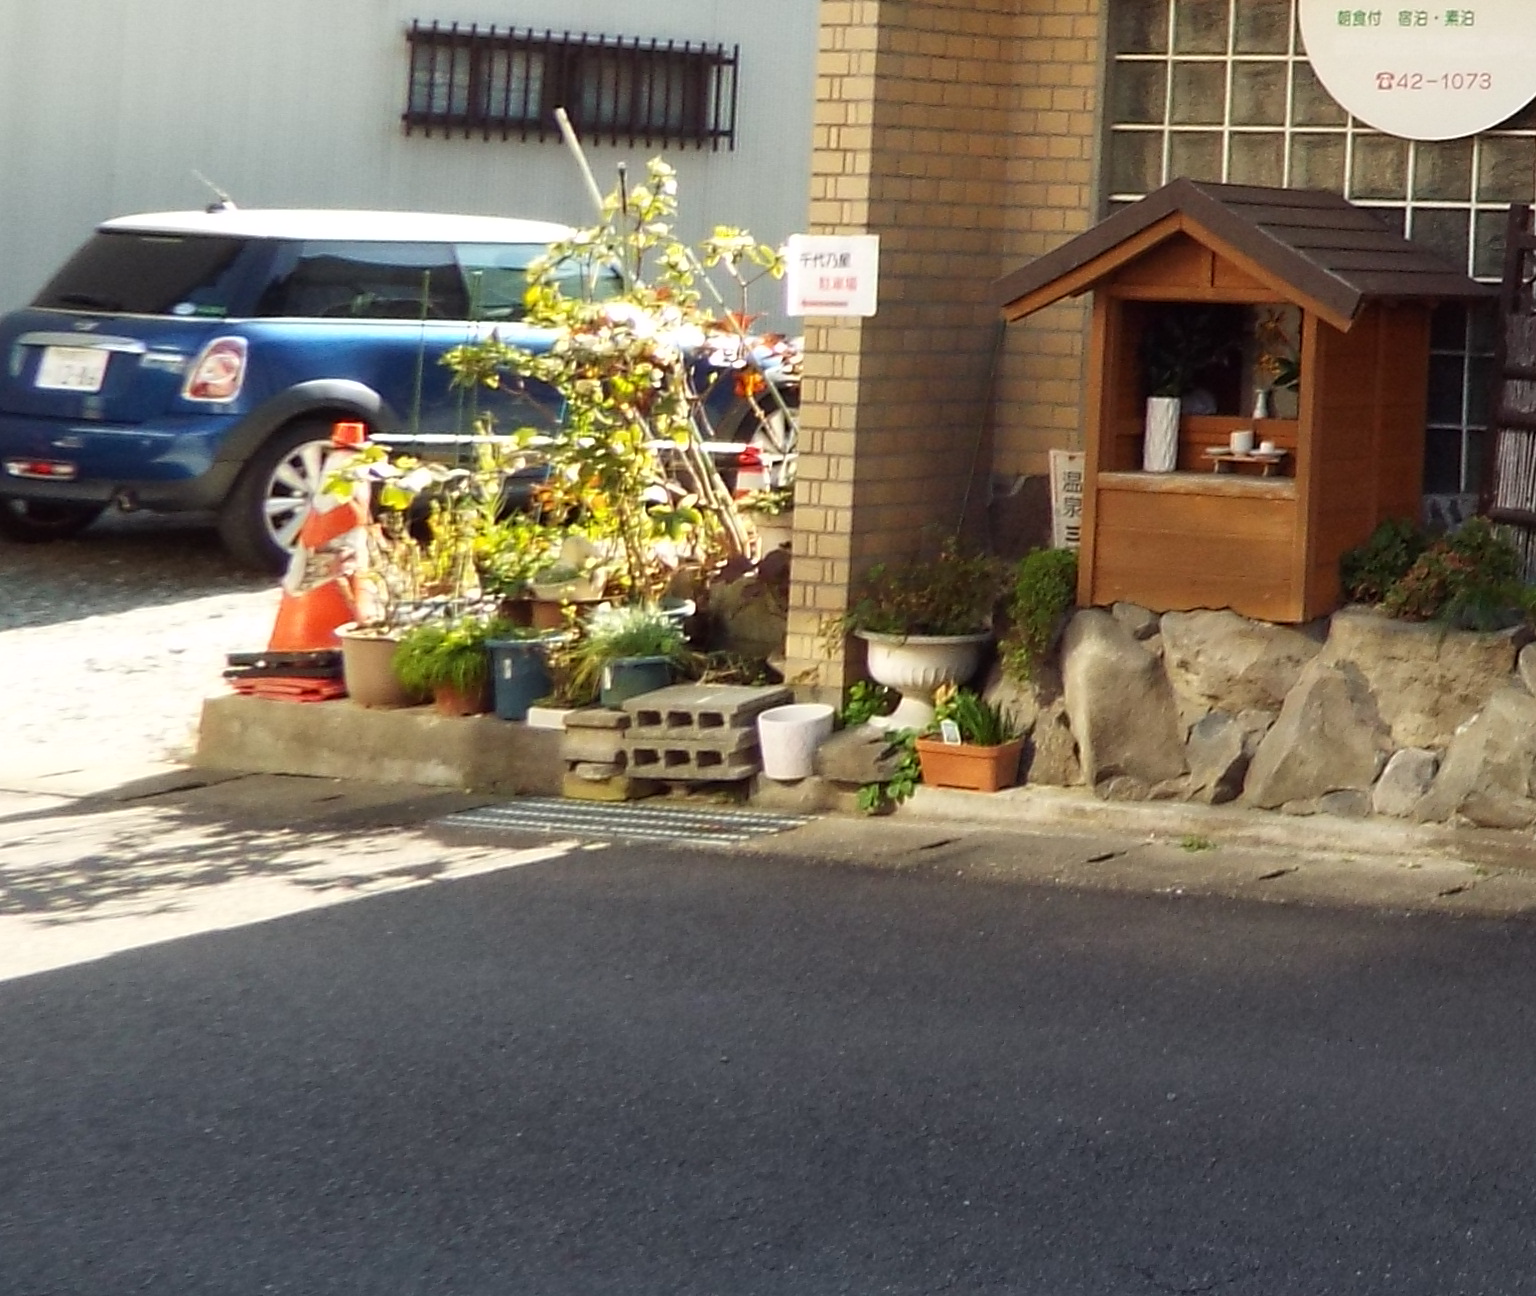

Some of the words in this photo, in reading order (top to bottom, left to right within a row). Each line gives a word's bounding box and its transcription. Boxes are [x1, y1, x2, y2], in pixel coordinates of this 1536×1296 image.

[1337, 9, 1382, 26] 朝食付
[1397, 73, 1492, 90] 42-1073
